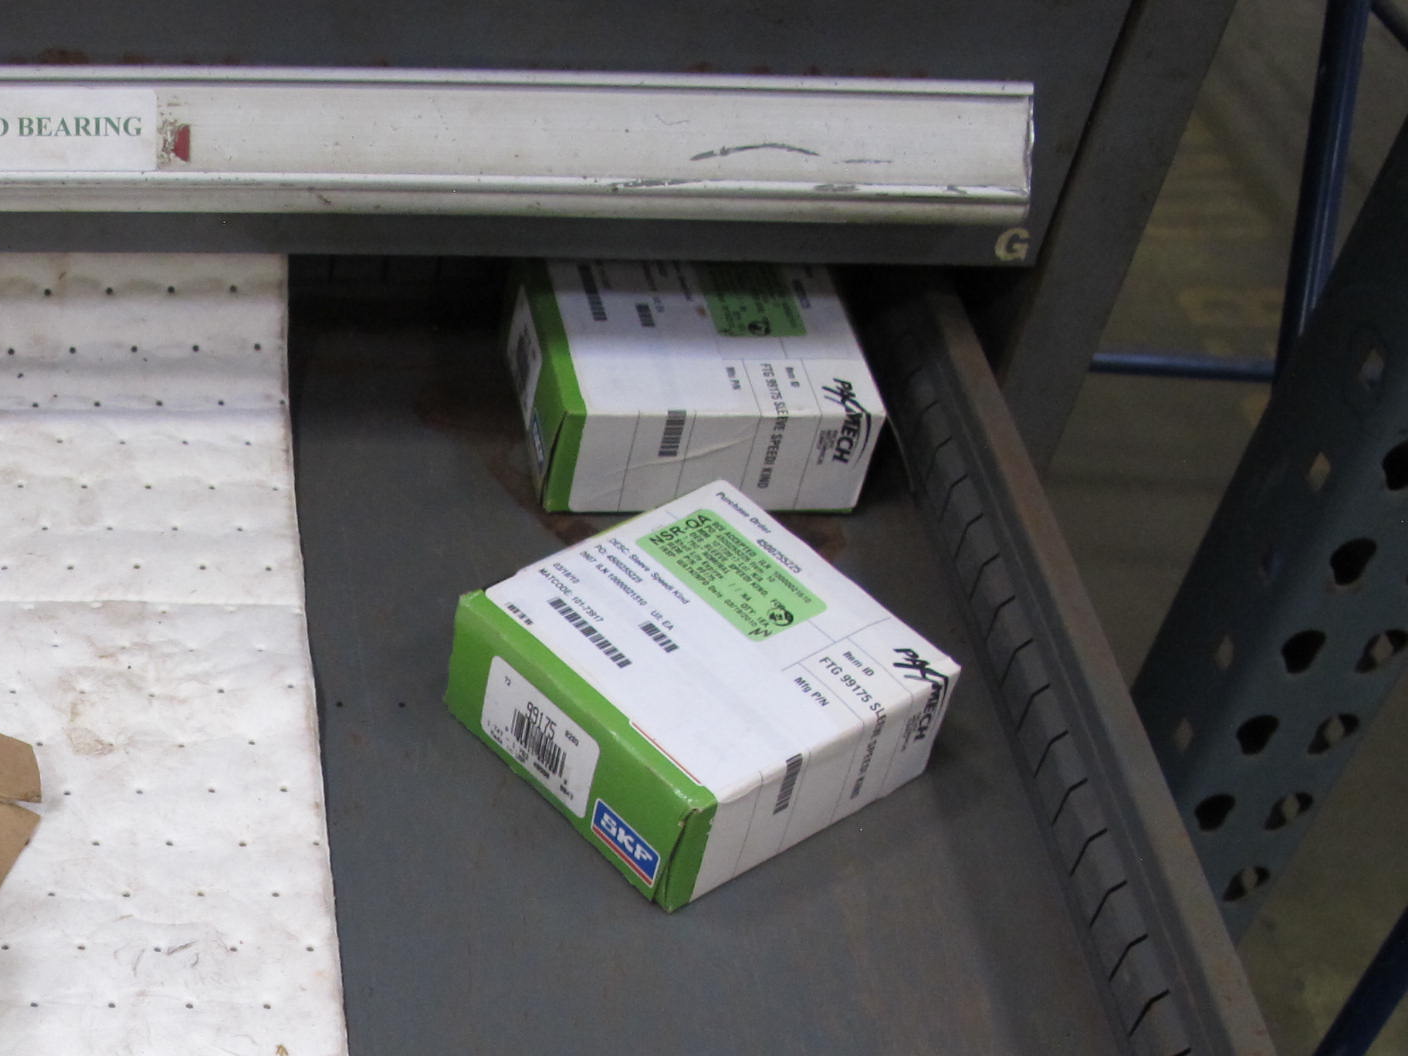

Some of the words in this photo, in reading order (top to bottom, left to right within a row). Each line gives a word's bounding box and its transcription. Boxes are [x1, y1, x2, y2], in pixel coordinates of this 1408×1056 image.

[18, 116, 143, 138] BEARING
[994, 227, 1031, 262] G
[649, 513, 710, 545] NSR-QA
[819, 656, 843, 676] FTG
[840, 674, 873, 703] 99175
[600, 811, 653, 864] SKF
